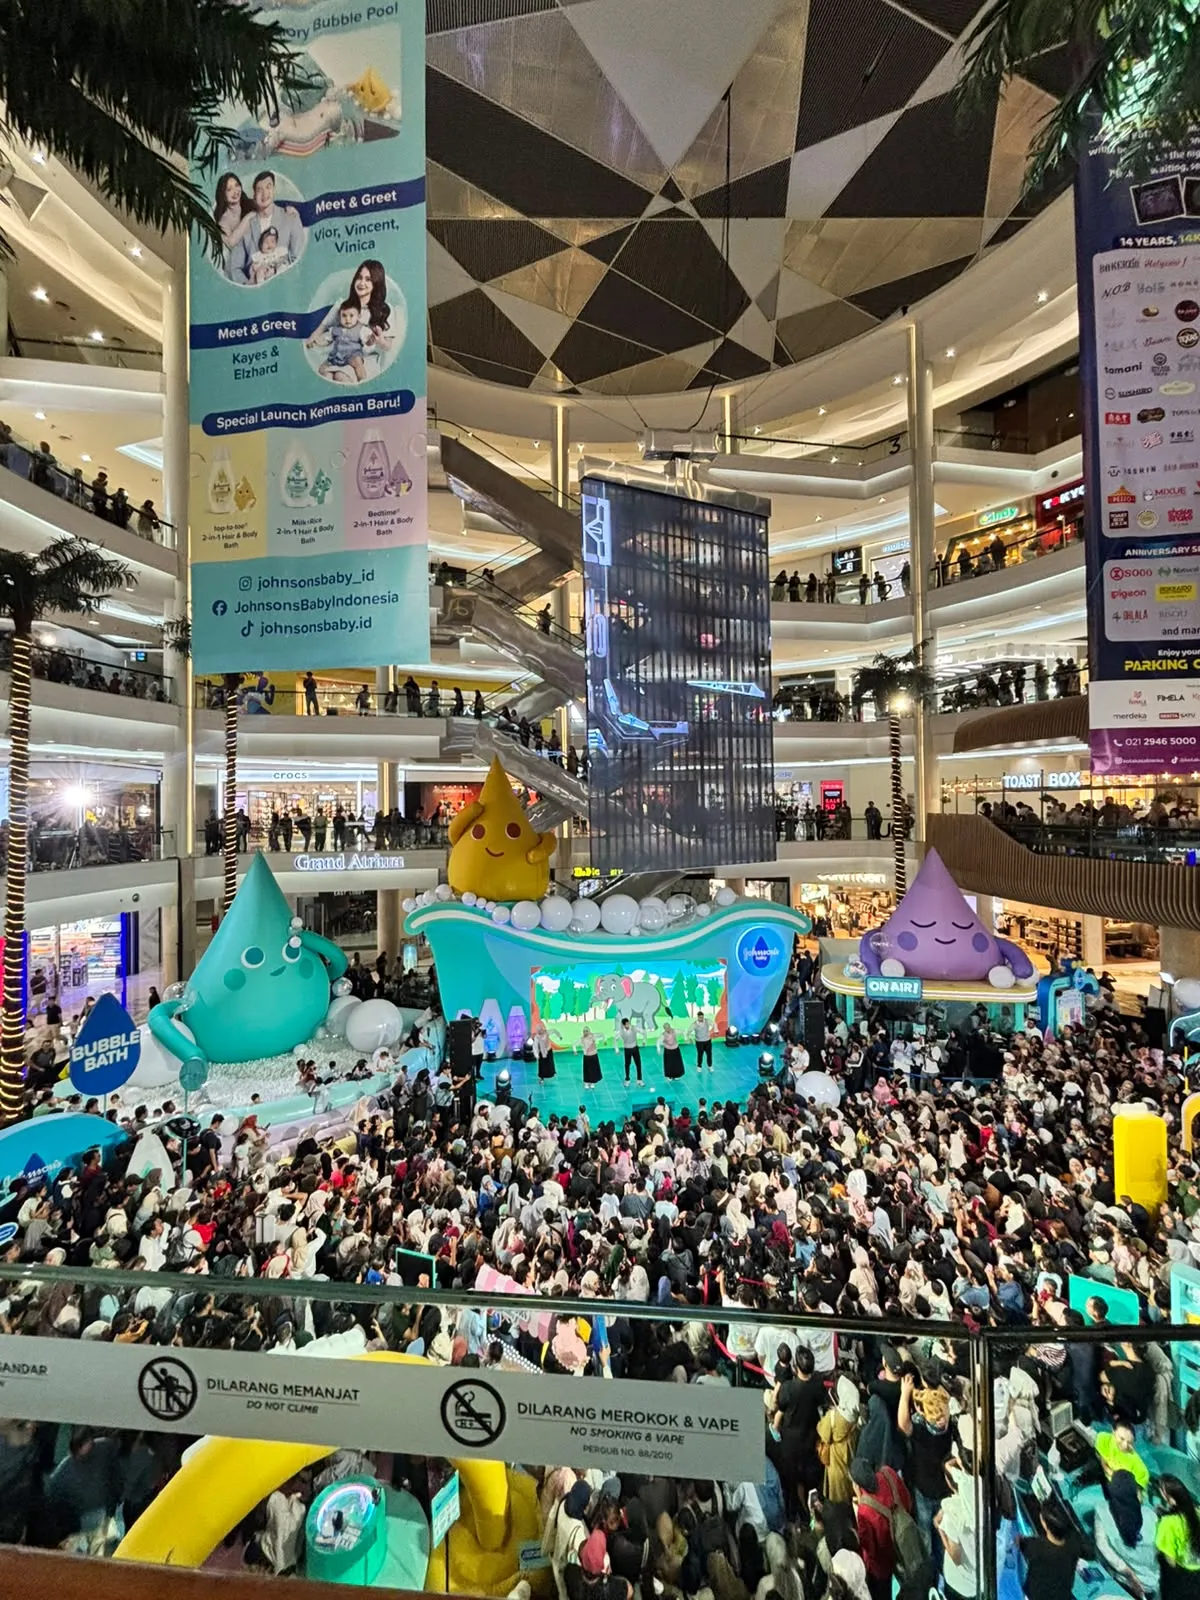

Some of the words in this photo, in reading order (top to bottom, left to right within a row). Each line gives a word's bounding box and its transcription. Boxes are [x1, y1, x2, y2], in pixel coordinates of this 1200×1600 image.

[313, 13, 362, 31] Bubble
[366, 3, 399, 21] Pool
[315, 198, 346, 216] Meet
[349, 196, 358, 210] &
[361, 190, 398, 206] Greet
[314, 224, 341, 243] Vior,
[345, 218, 400, 238] Vincent,
[335, 239, 376, 254] Vinica
[1120, 237, 1134, 247] 14
[1135, 235, 1178, 247] YEARS,
[218, 324, 248, 341] Meet
[250, 322, 259, 336] &
[261, 319, 297, 332] Greet
[232, 350, 268, 367] Kayes
[270, 345, 280, 358] &
[233, 363, 279, 381] Elzhard
[216, 412, 258, 430] Special
[261, 408, 307, 422] Launch
[310, 401, 363, 419] Kemasan
[367, 396, 401, 411] Baru!
[889, 437, 901, 455] 3
[319, 524, 335, 533] Body
[353, 521, 373, 529] 2-in-1
[374, 519, 389, 527] Hair
[397, 516, 414, 525] Body
[202, 534, 221, 542] 2-in-1
[242, 530, 258, 538] Body
[300, 537, 316, 545] Bath
[1124, 546, 1190, 557] ANNIVERSARY
[257, 569, 375, 592] johnsonsbaby_id
[234, 591, 400, 614] JohnsonsBabyIndonesia
[260, 616, 373, 638] johnsonsbaby.id
[1162, 626, 1179, 636] and
[1158, 649, 1180, 657] Enjoy
[1124, 659, 1189, 672] PARKING
[1113, 712, 1147, 720] merdeka
[1125, 738, 1141, 746] 021
[1143, 737, 1167, 746] 2946
[1170, 736, 1197, 745] 5000
[273, 771, 308, 780] crocs
[1003, 773, 1041, 789] TOAST
[1049, 772, 1082, 787] BOX
[294, 853, 346, 871] Grand
[348, 853, 405, 871] Atrium
[869, 980, 889, 993] ON
[890, 981, 918, 995] AIR!
[71, 1029, 141, 1062] BUBBLE
[83, 1047, 129, 1073] BATH
[0, 1362, 48, 1376] ANDAR
[207, 1378, 279, 1396] DILARANG
[283, 1384, 360, 1401] MEMANJAT
[246, 1401, 263, 1411] DO
[264, 1402, 285, 1412] NOT
[287, 1404, 319, 1415] CLIMB
[517, 1402, 597, 1421] DILARANG
[601, 1409, 679, 1427] MEROKOK
[683, 1415, 694, 1428] &
[698, 1416, 740, 1432] VAPE
[570, 1426, 587, 1436] NO
[590, 1427, 642, 1442] SMOKING
[645, 1432, 653, 1442] &
[656, 1432, 685, 1446] VAPE
[583, 1445, 618, 1456] PERGUB
[621, 1448, 637, 1457] NO.
[638, 1449, 673, 1461] 88/2010
